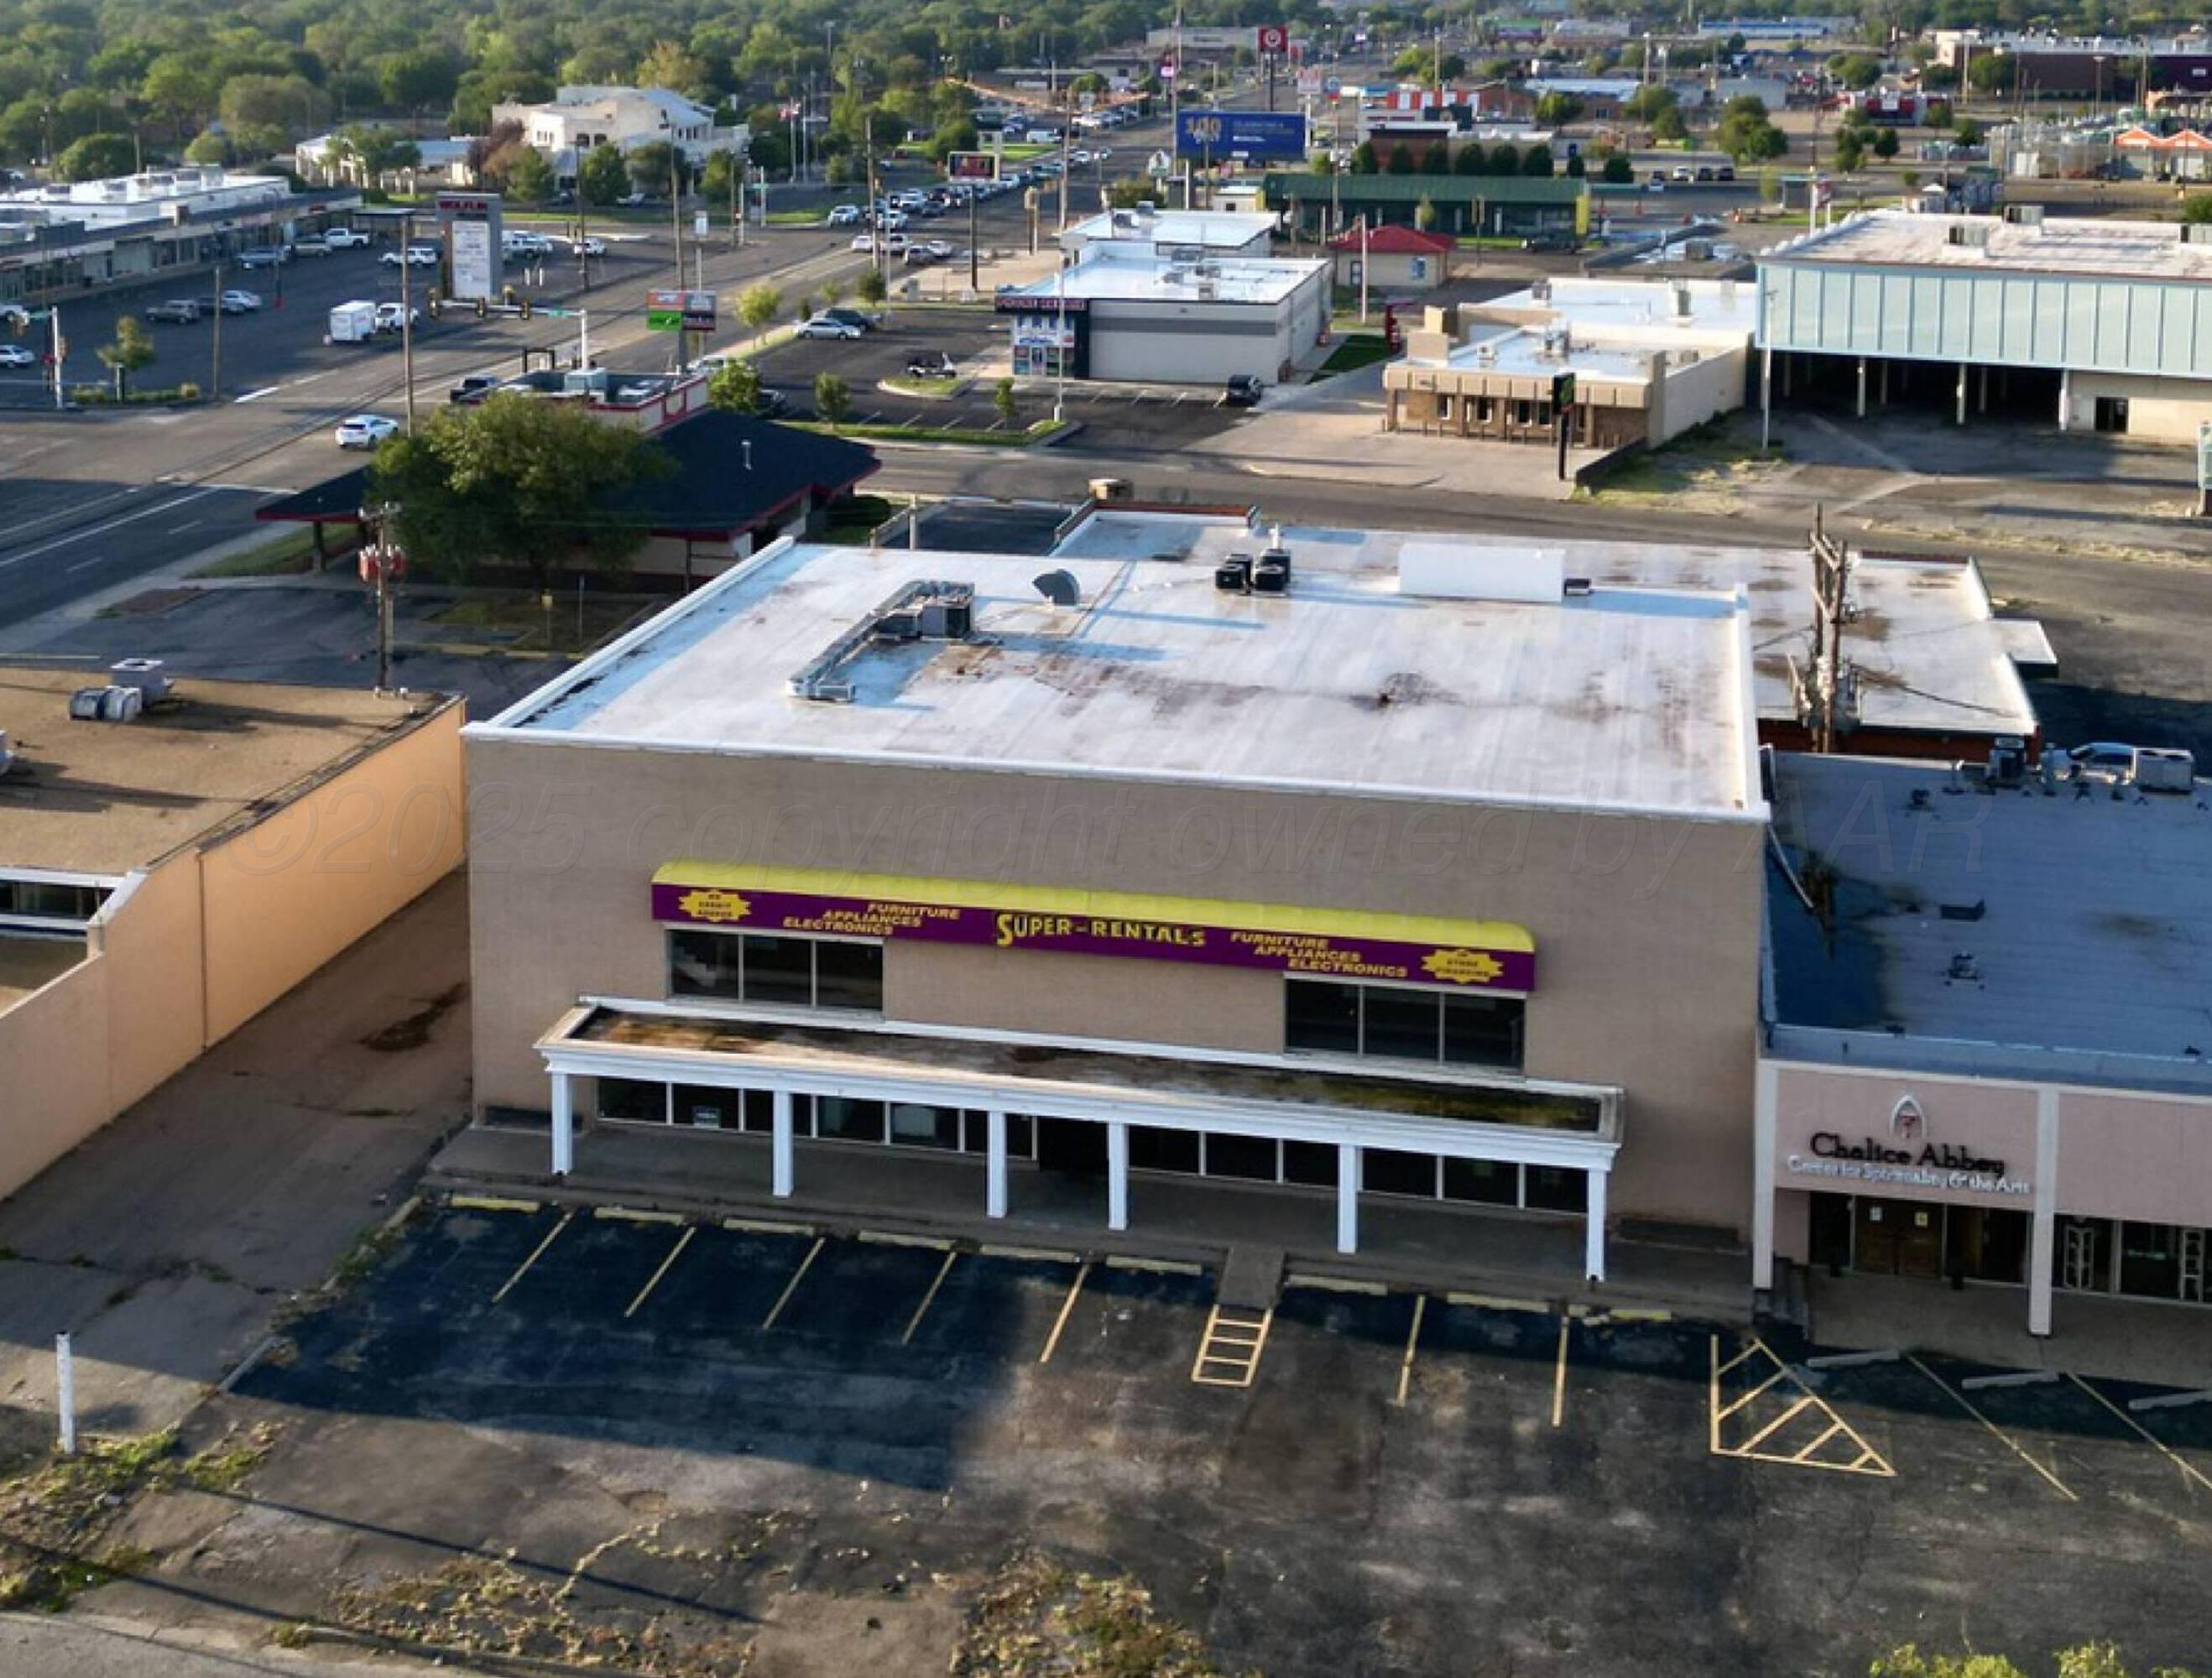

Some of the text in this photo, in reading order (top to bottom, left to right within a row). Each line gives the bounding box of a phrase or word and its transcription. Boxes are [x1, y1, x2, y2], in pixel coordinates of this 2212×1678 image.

[822, 909, 921, 927] APPLIANCES
[867, 903, 961, 920] FURNITURE
[782, 916, 895, 935] ELECTRONICS
[1230, 930, 1329, 949] FURNITURE
[1255, 945, 1362, 963] APPLIANCES
[1287, 956, 1408, 977] ELECTRONICS
[1917, 1143, 2005, 1180] Abbey
